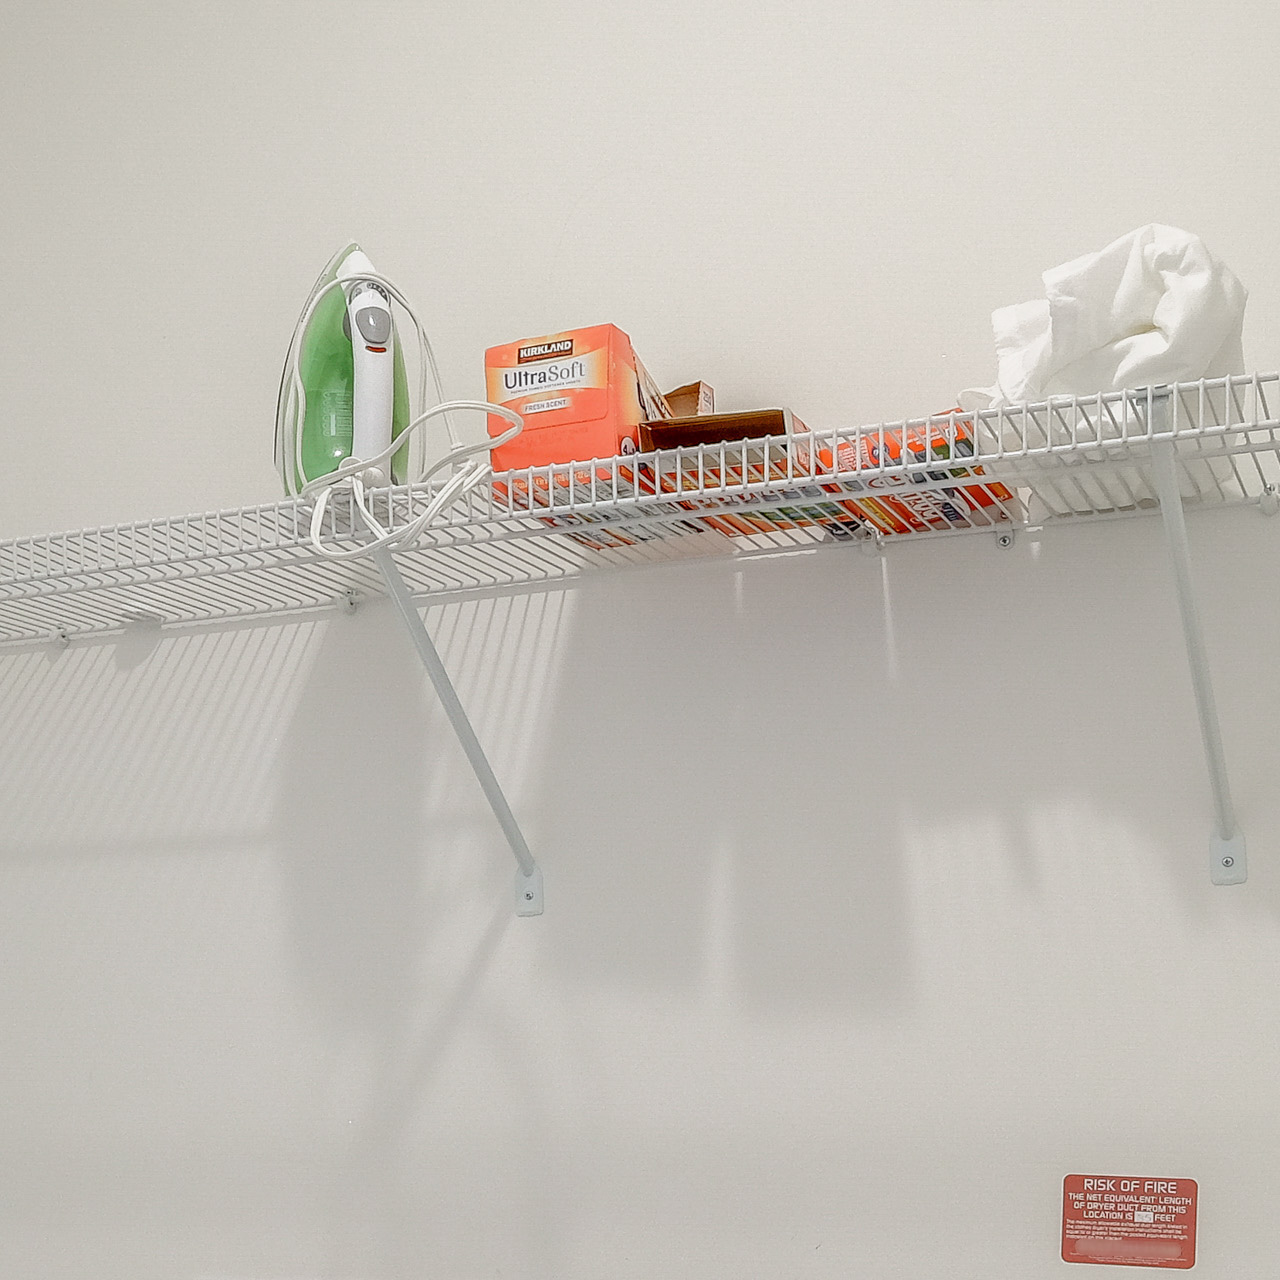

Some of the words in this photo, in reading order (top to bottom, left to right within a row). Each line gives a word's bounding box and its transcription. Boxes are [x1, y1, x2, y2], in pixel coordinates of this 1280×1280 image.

[520, 341, 573, 359] KIRKLAND
[525, 401, 545, 412] FRESH
[546, 400, 567, 410] SCENT
[1084, 1178, 1116, 1191] RISK
[1120, 1180, 1140, 1192] OF
[1144, 1181, 1177, 1194] FIRE
[1068, 1192, 1085, 1200] THE
[1086, 1193, 1102, 1201] NET
[1159, 1196, 1192, 1205] LENGTH
[1073, 1201, 1086, 1209] OF
[1087, 1202, 1115, 1211] DRYER
[1117, 1203, 1139, 1211] DUCT
[1140, 1204, 1166, 1213] FROM
[1168, 1206, 1186, 1214] THIS
[1083, 1210, 1123, 1220] LOCATION
[1125, 1212, 1133, 1220] IS
[1154, 1214, 1176, 1222] FEET
